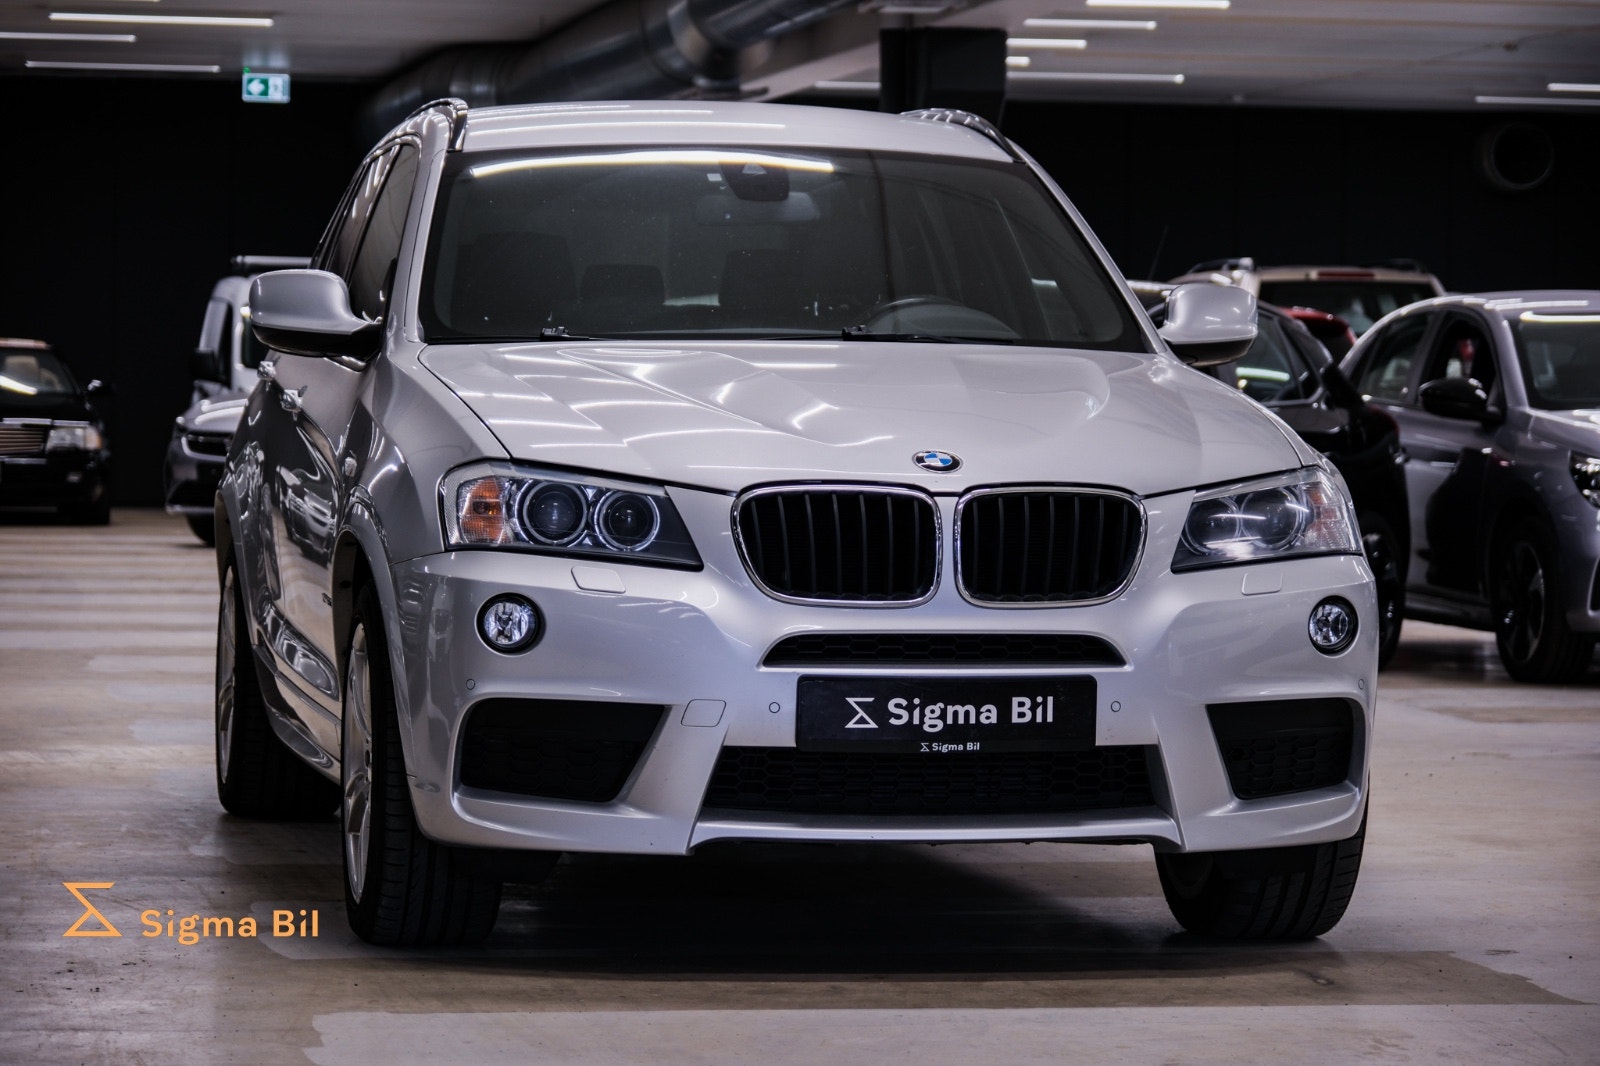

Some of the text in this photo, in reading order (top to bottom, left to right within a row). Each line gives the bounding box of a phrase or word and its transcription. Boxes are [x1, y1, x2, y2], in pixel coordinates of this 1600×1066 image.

[887, 696, 1054, 733] Sigma Bil
[932, 742, 980, 753] Sigma Bil
